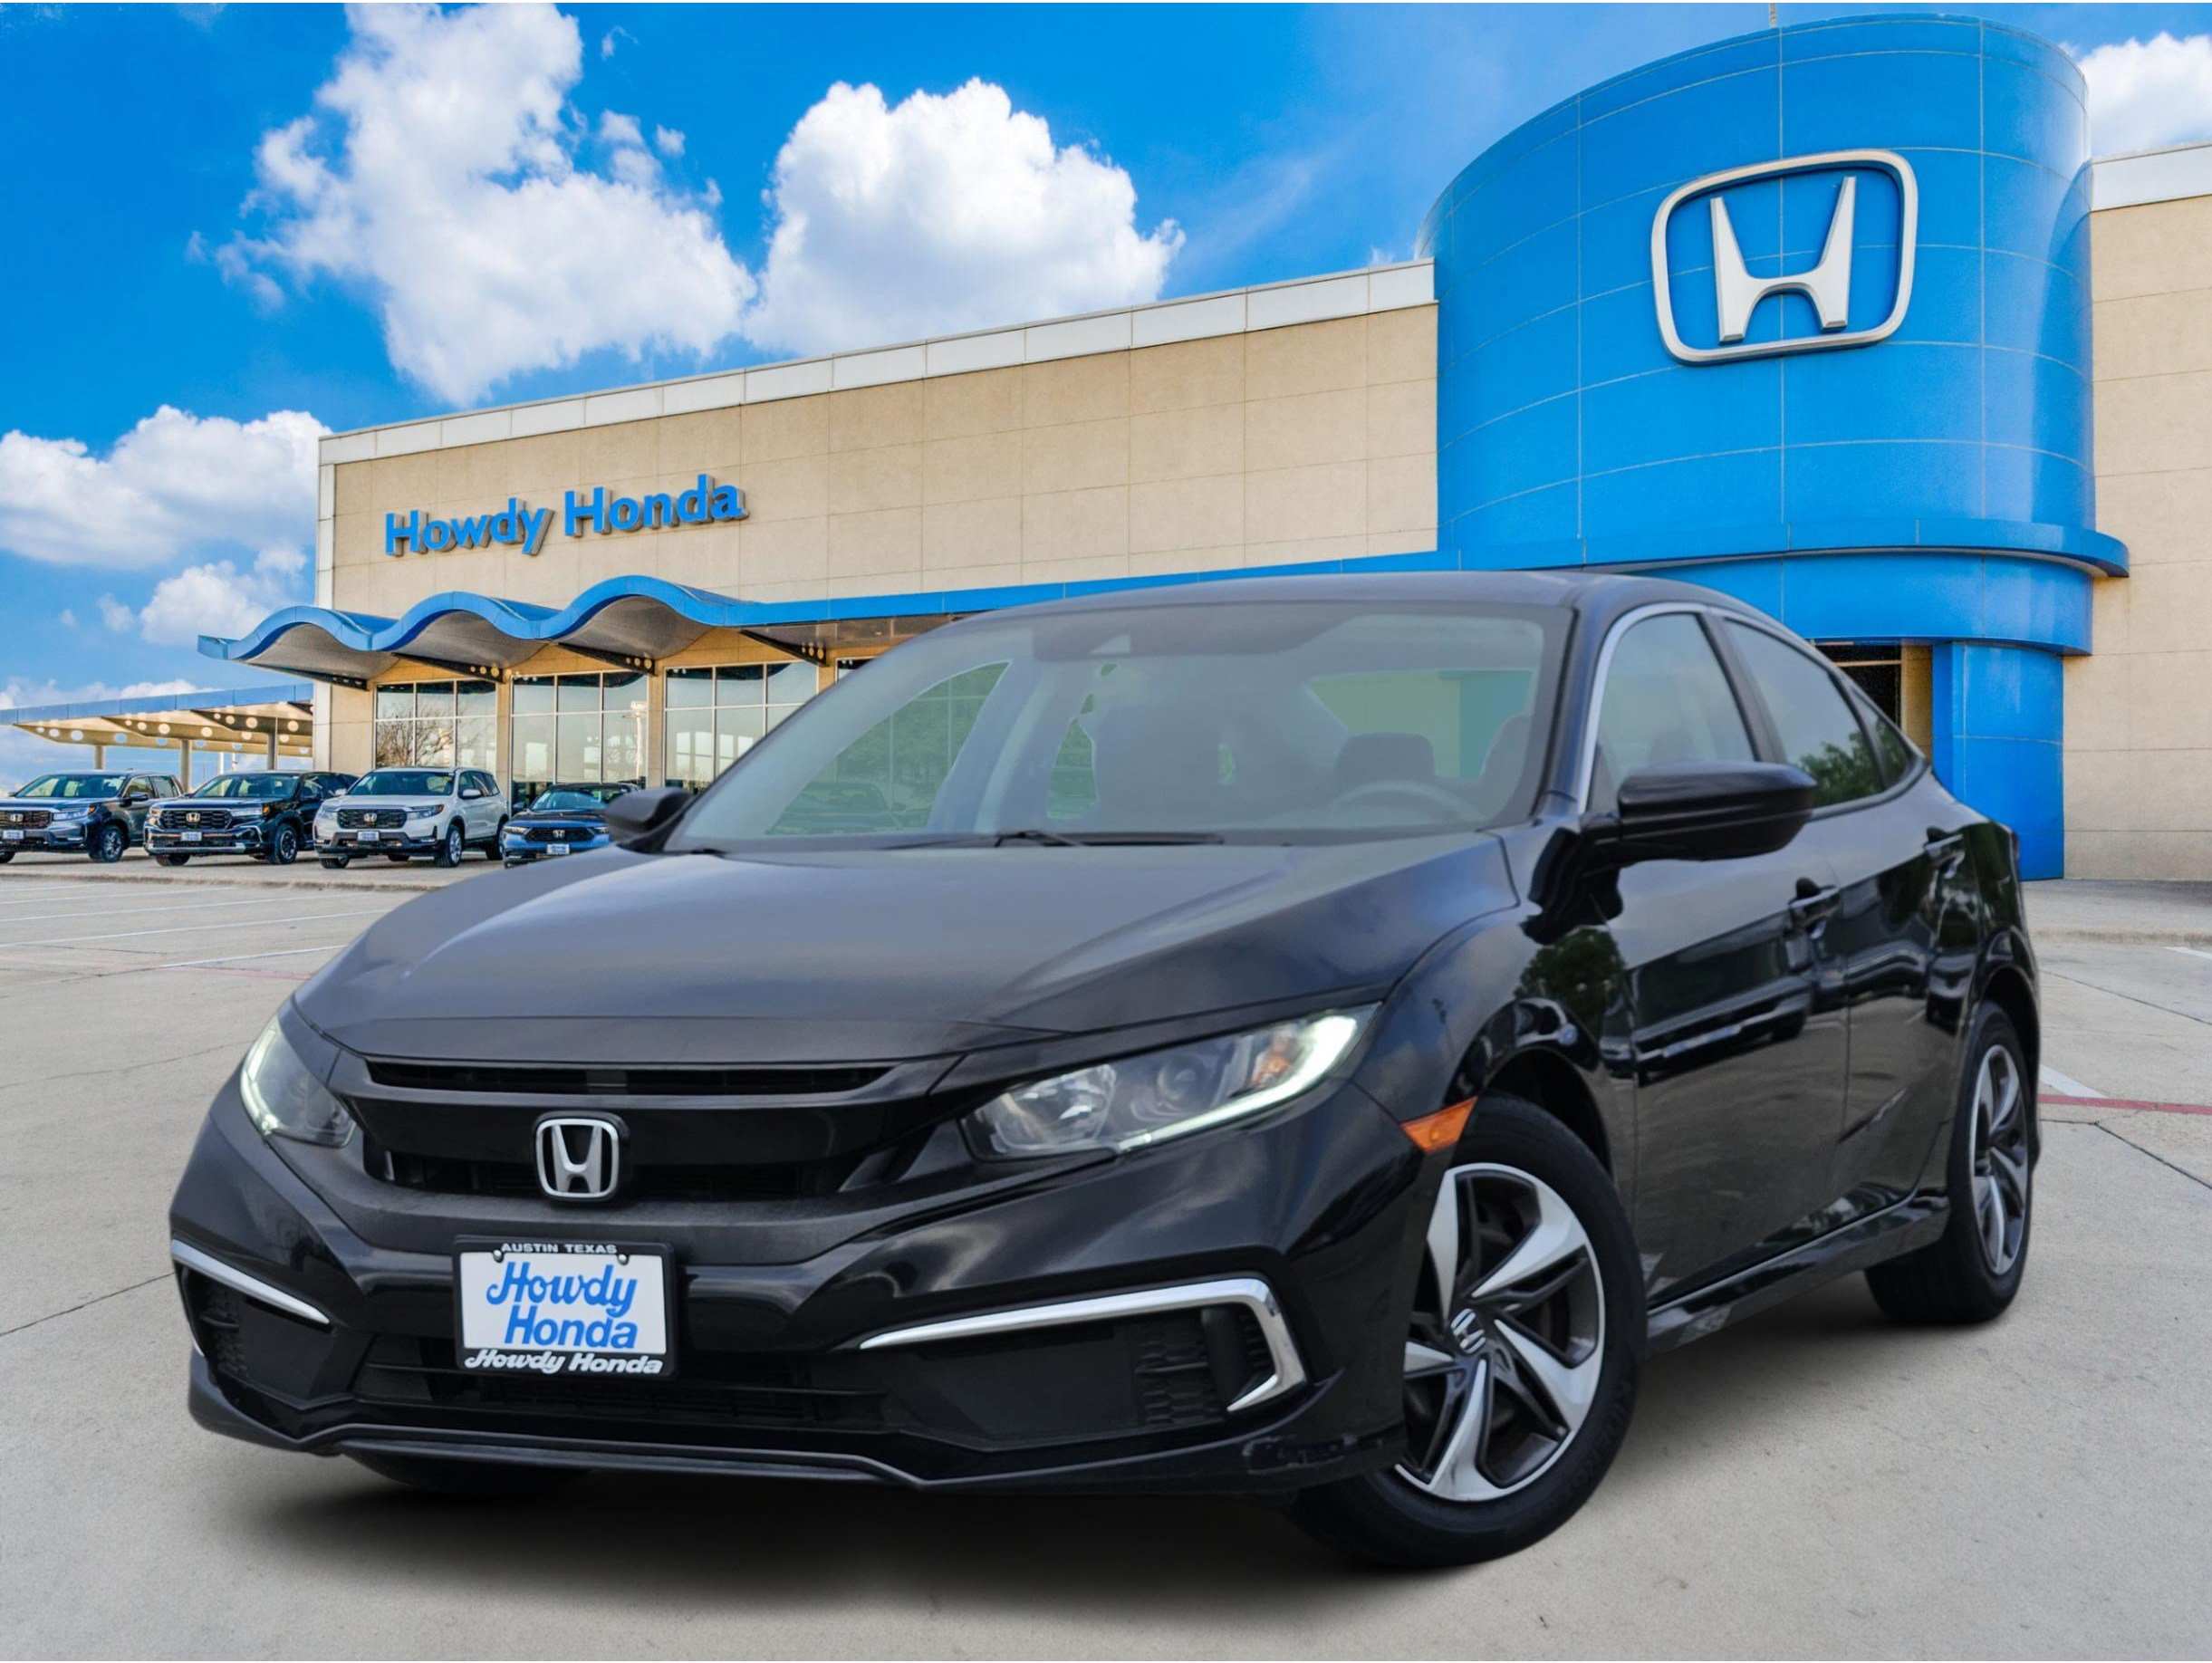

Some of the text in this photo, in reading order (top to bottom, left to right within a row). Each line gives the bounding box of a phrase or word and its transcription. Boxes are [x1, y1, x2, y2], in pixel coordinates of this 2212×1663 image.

[385, 474, 749, 556] Howdy Honda
[501, 1243, 618, 1254] AUSTIN TEXAS
[486, 1261, 638, 1318] Howdy
[504, 1305, 639, 1349] Honda
[464, 1349, 663, 1374] Howdy Honda
